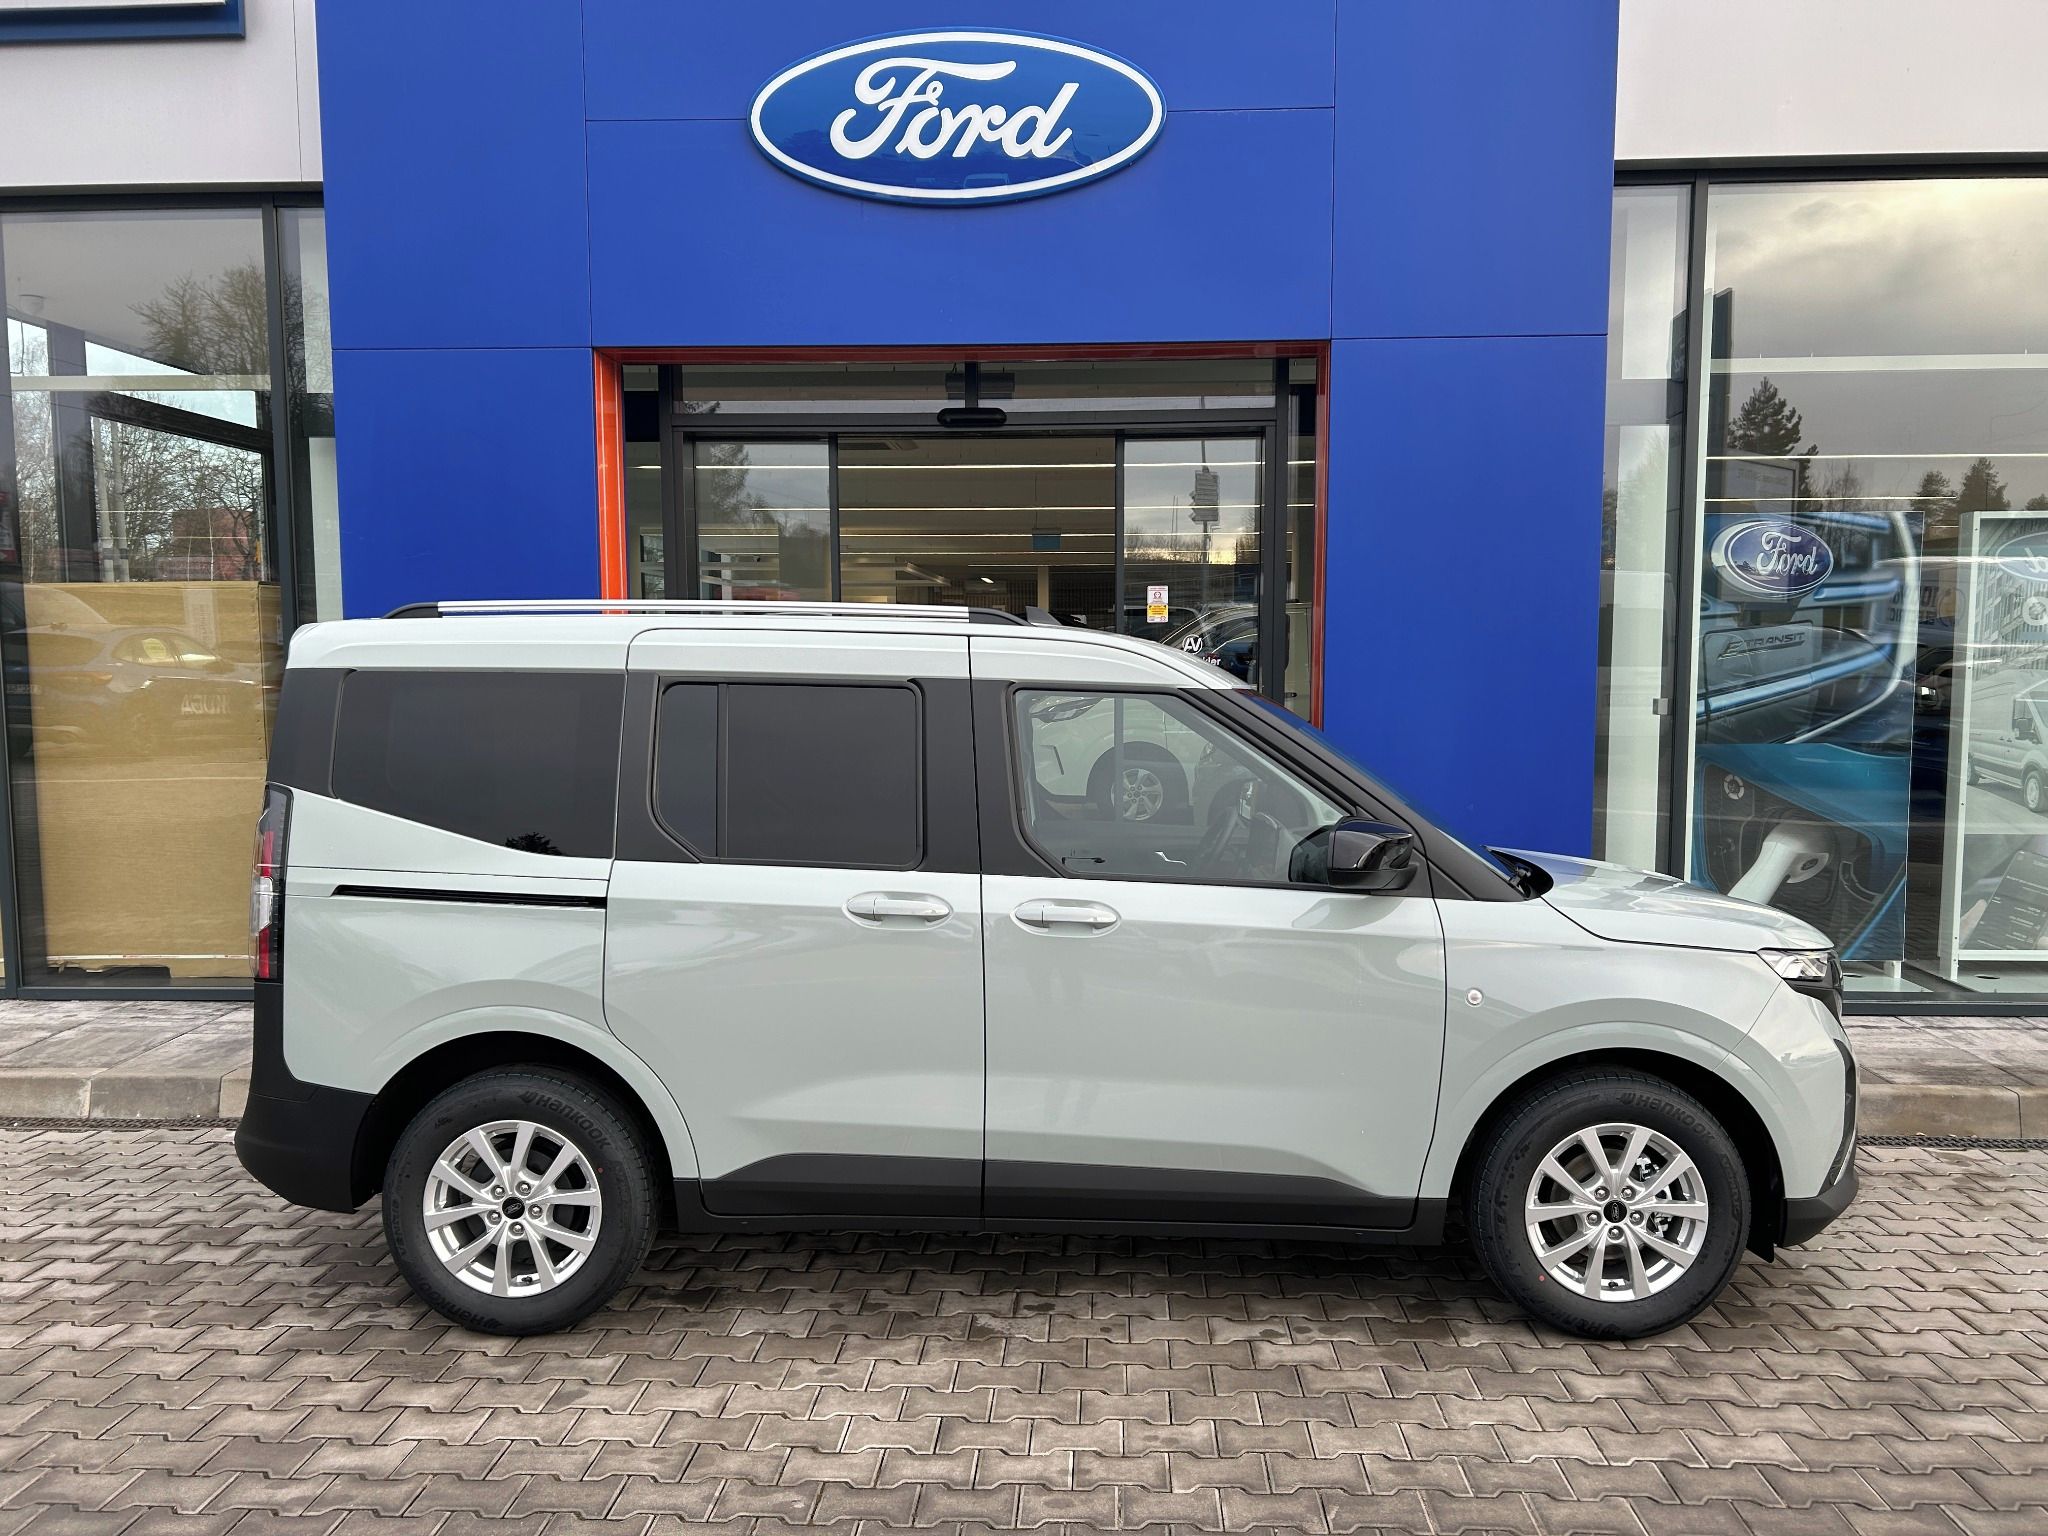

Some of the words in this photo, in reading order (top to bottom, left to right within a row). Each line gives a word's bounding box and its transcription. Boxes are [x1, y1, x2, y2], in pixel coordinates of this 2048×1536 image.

[830, 57, 1079, 159] Ford
[1756, 531, 1818, 575] Ford
[1744, 632, 1805, 648] TRANSIT
[536, 1094, 612, 1150] Hankook
[1636, 1095, 1715, 1144] Hankook
